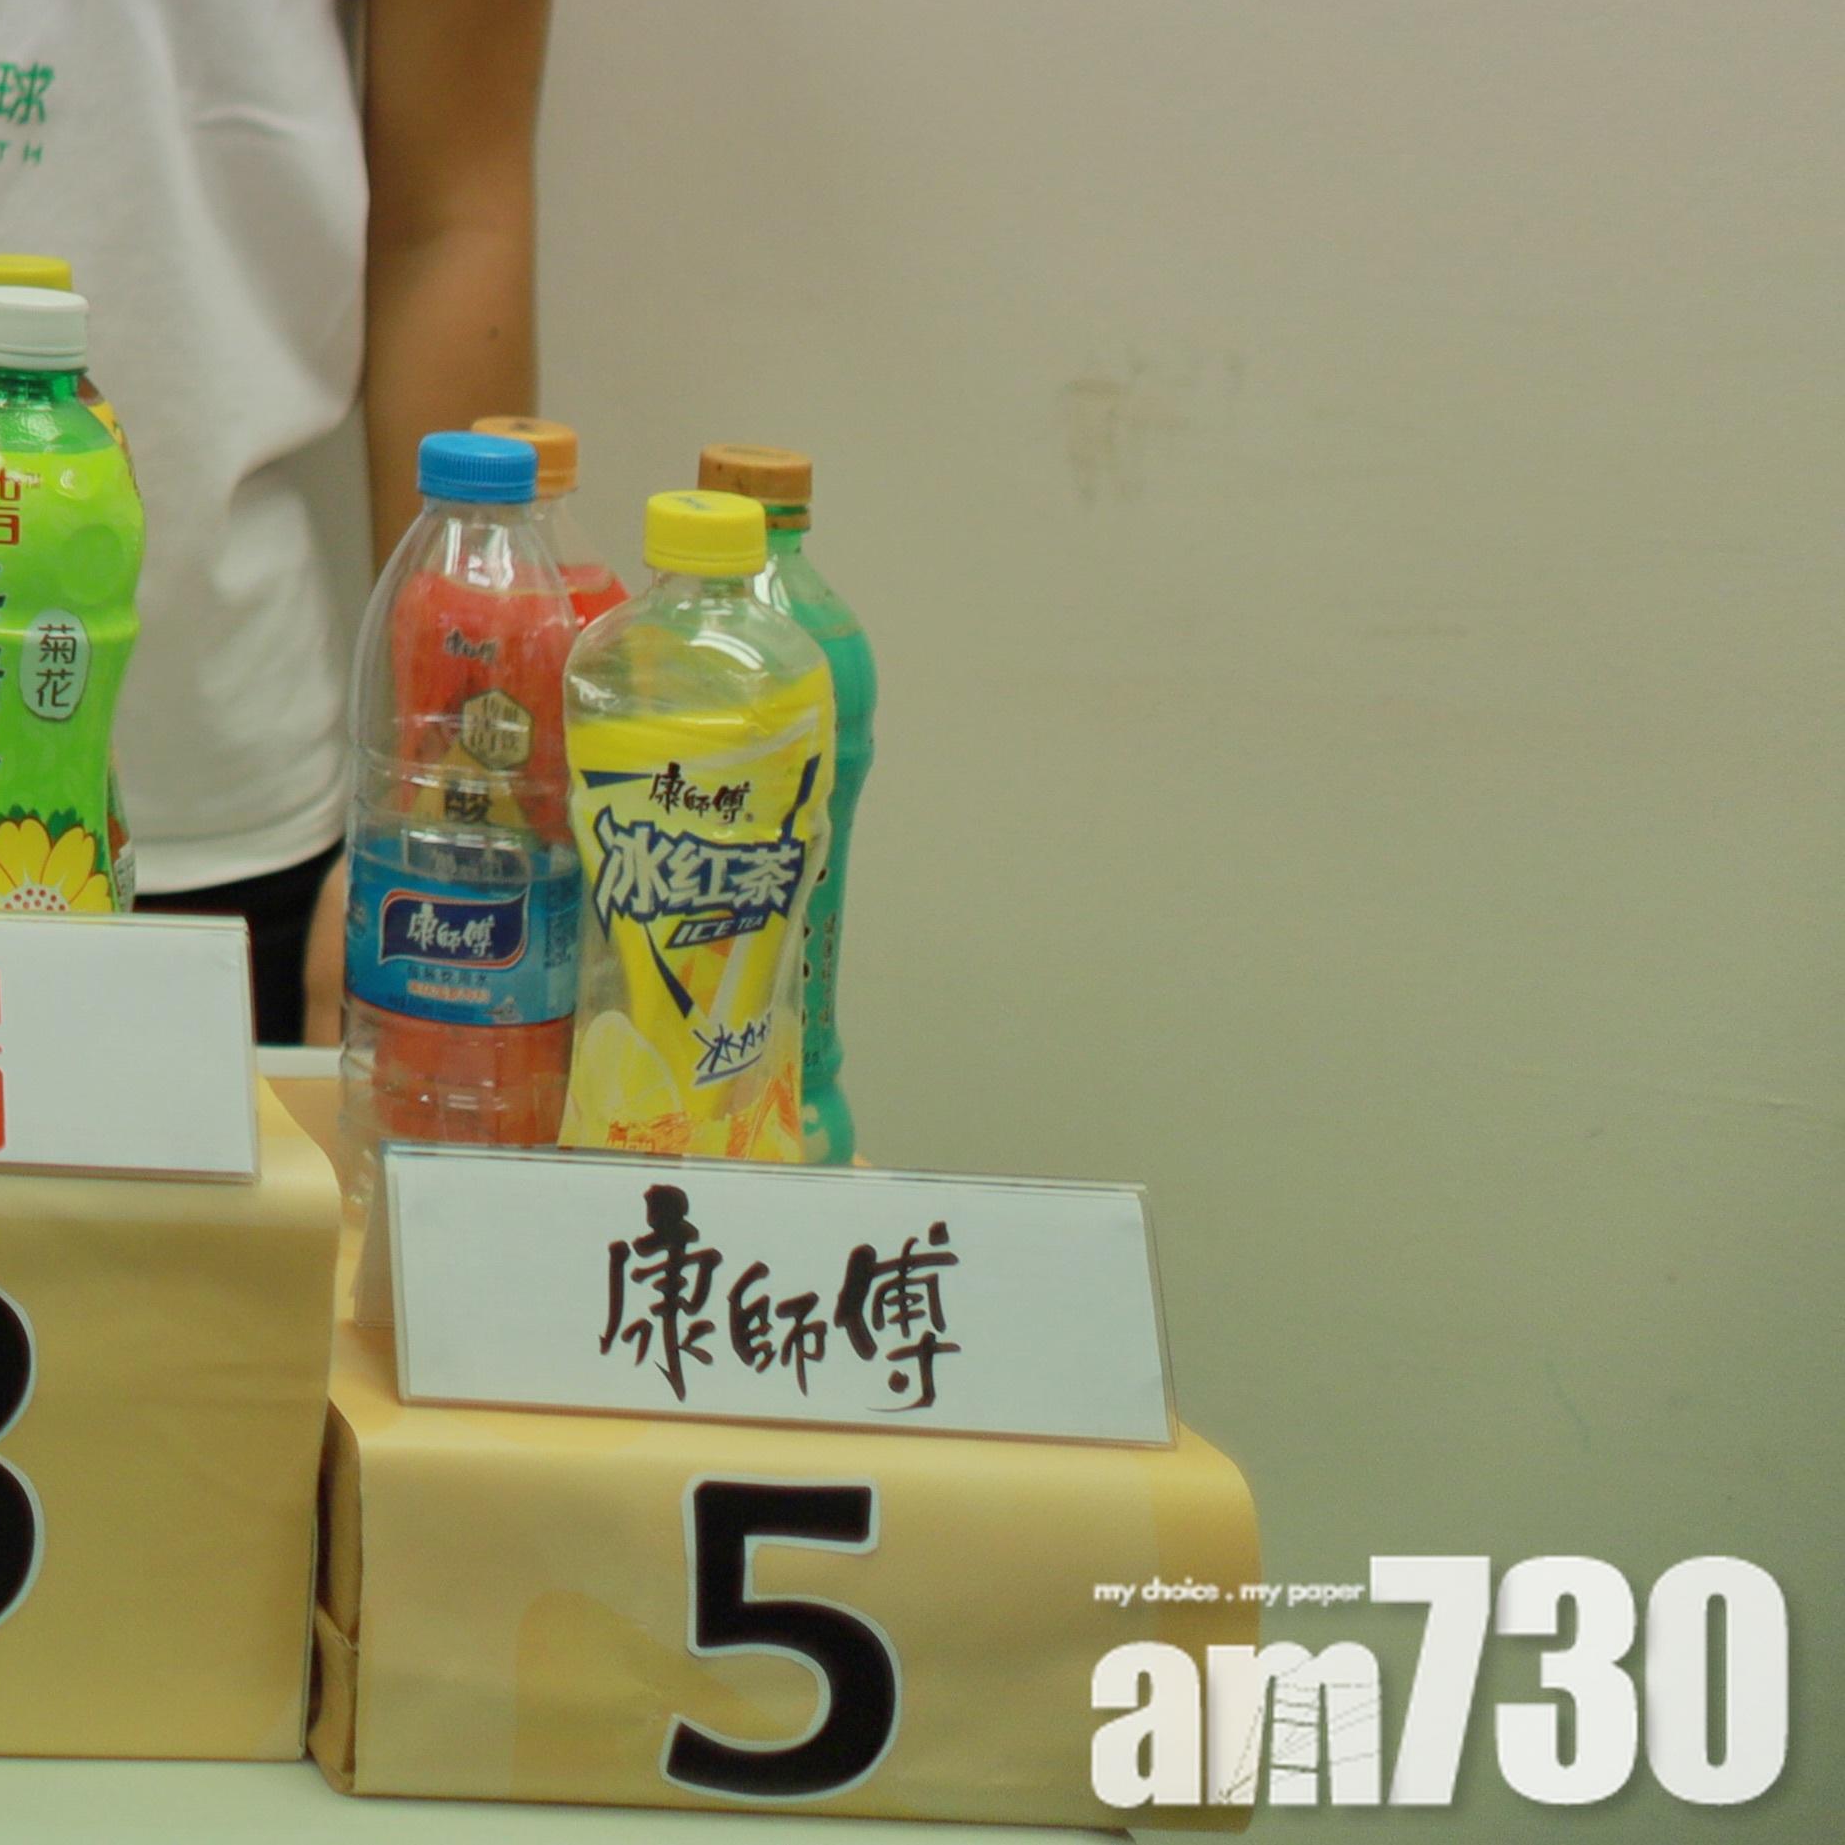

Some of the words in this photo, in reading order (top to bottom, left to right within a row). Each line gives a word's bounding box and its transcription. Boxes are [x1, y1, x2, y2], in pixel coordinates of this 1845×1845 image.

[35, 623, 78, 708] 菊花
[649, 761, 752, 825] 康師傅
[595, 811, 806, 924] 冰红茶
[406, 901, 496, 958] 康師傅
[672, 920, 733, 946] ICE
[736, 915, 765, 934] TEA
[599, 1184, 962, 1411] 康師傅
[665, 1480, 899, 1799] 5
